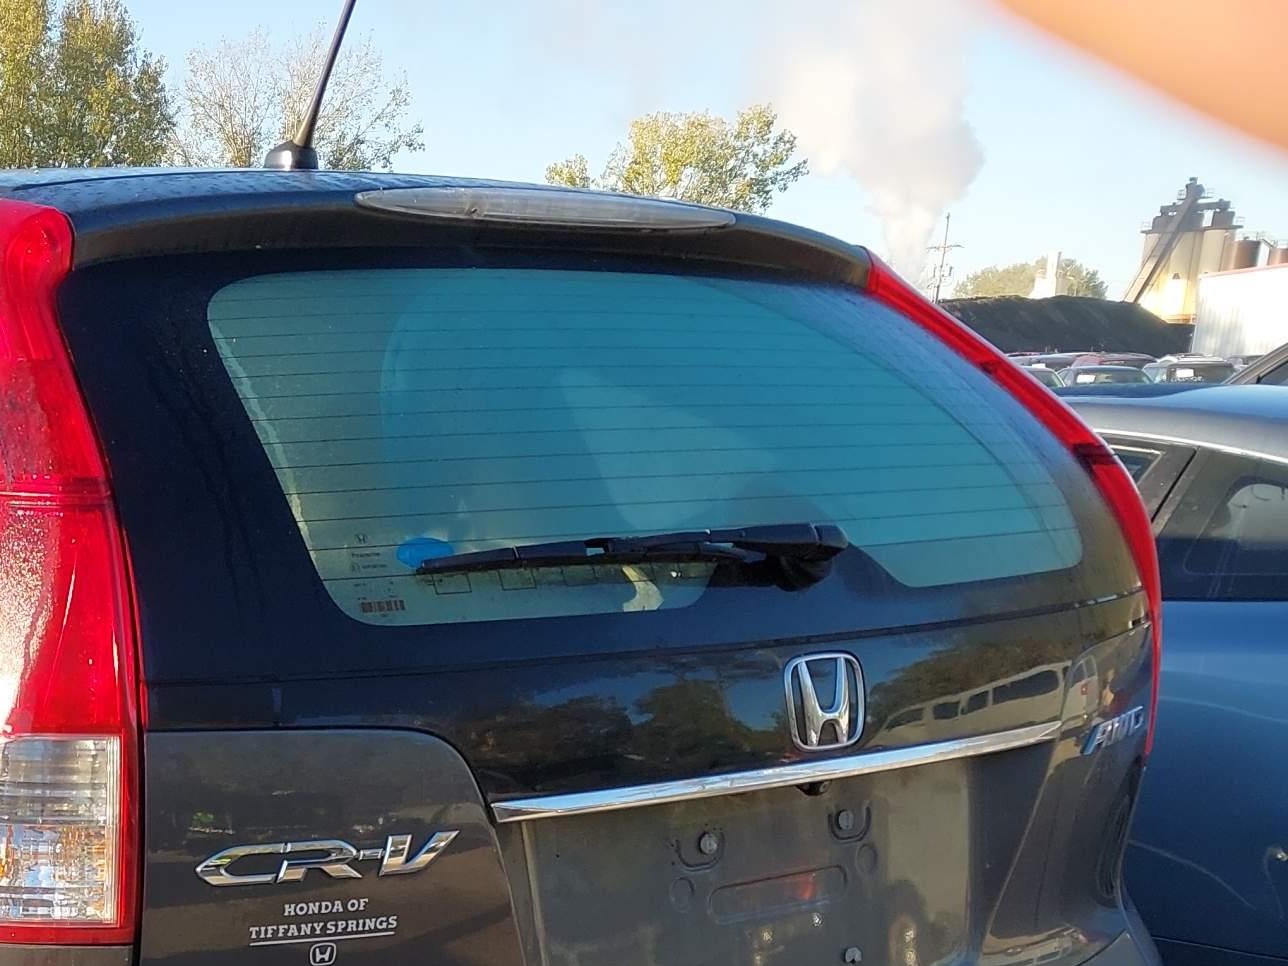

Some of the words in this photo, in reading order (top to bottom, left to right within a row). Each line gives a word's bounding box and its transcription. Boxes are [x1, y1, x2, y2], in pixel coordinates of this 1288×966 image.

[194, 829, 461, 887] CR-V
[283, 900, 344, 916] HONDA
[347, 898, 369, 912] OF
[249, 921, 325, 939] TIFFANY
[326, 915, 398, 934] SPRINGS
